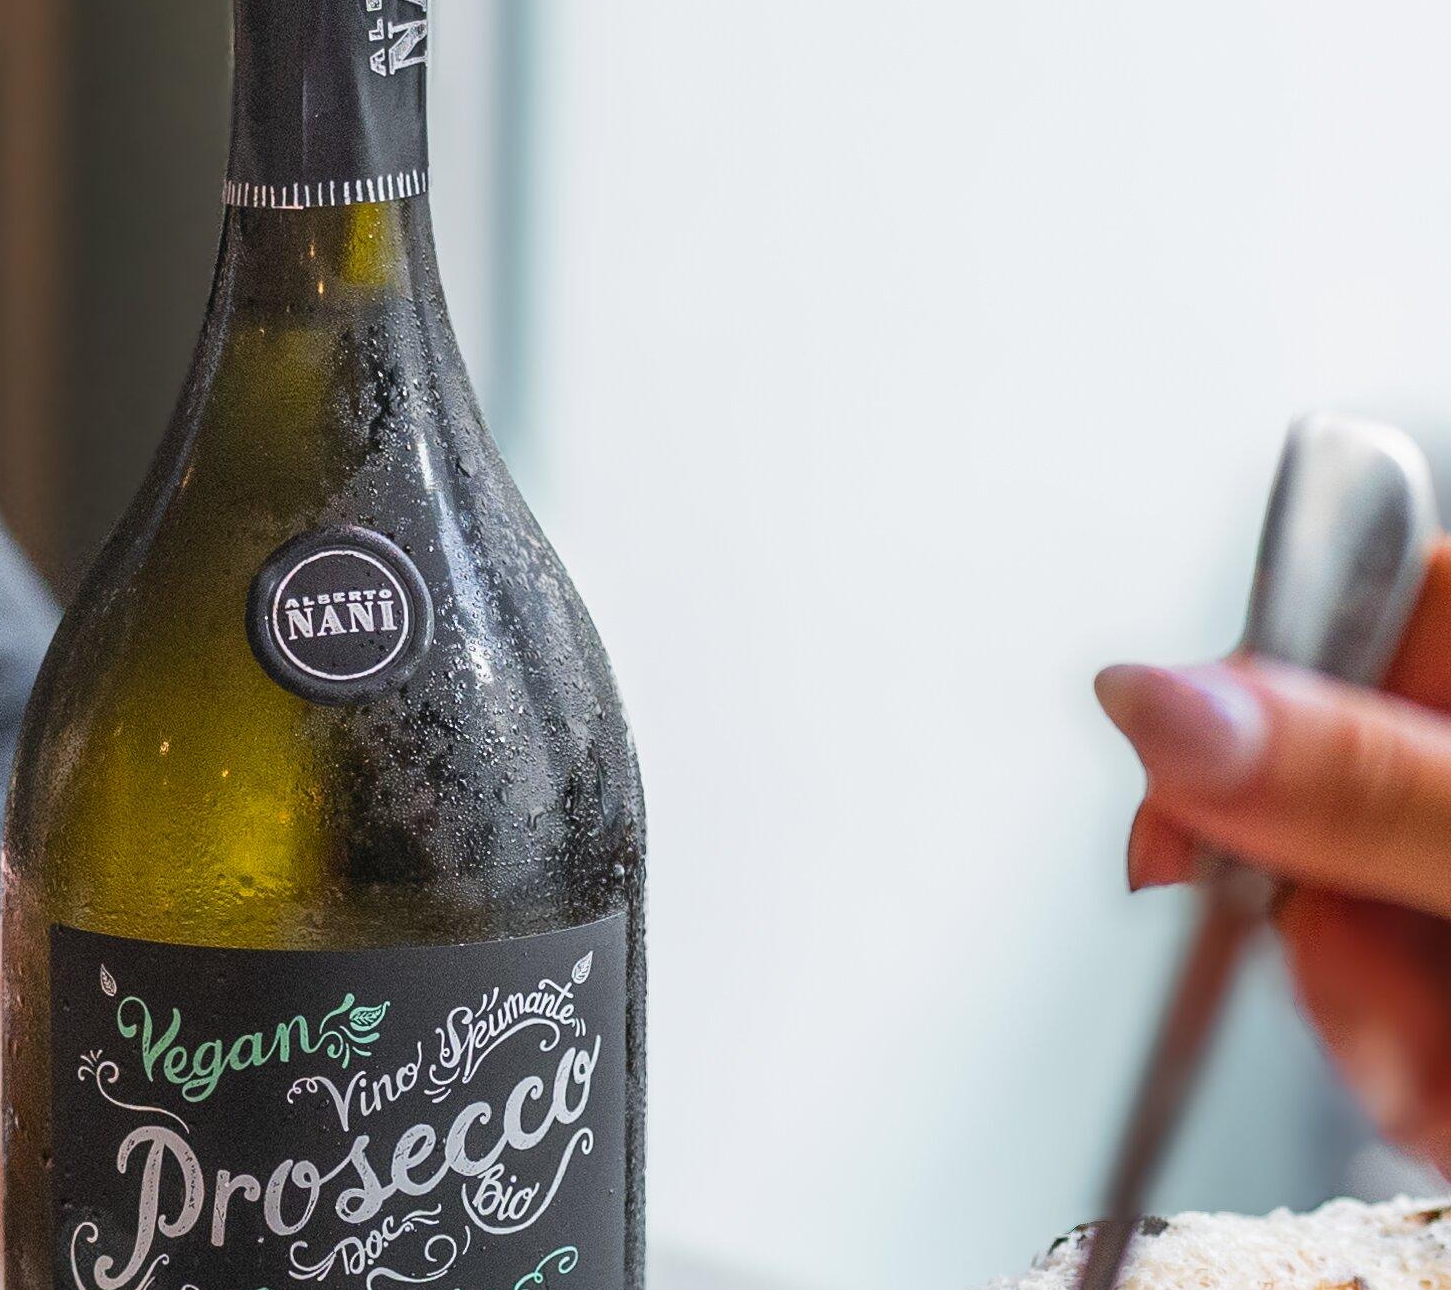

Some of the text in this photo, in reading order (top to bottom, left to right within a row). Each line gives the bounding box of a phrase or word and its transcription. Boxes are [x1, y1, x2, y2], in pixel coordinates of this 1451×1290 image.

[284, 589, 393, 610] ALBERTO
[285, 600, 398, 641] NANI
[116, 996, 321, 1102] Vegan
[289, 979, 577, 1132] Vino Spumante
[96, 1035, 601, 1290] Prosecco
[472, 1163, 541, 1221] Bio
